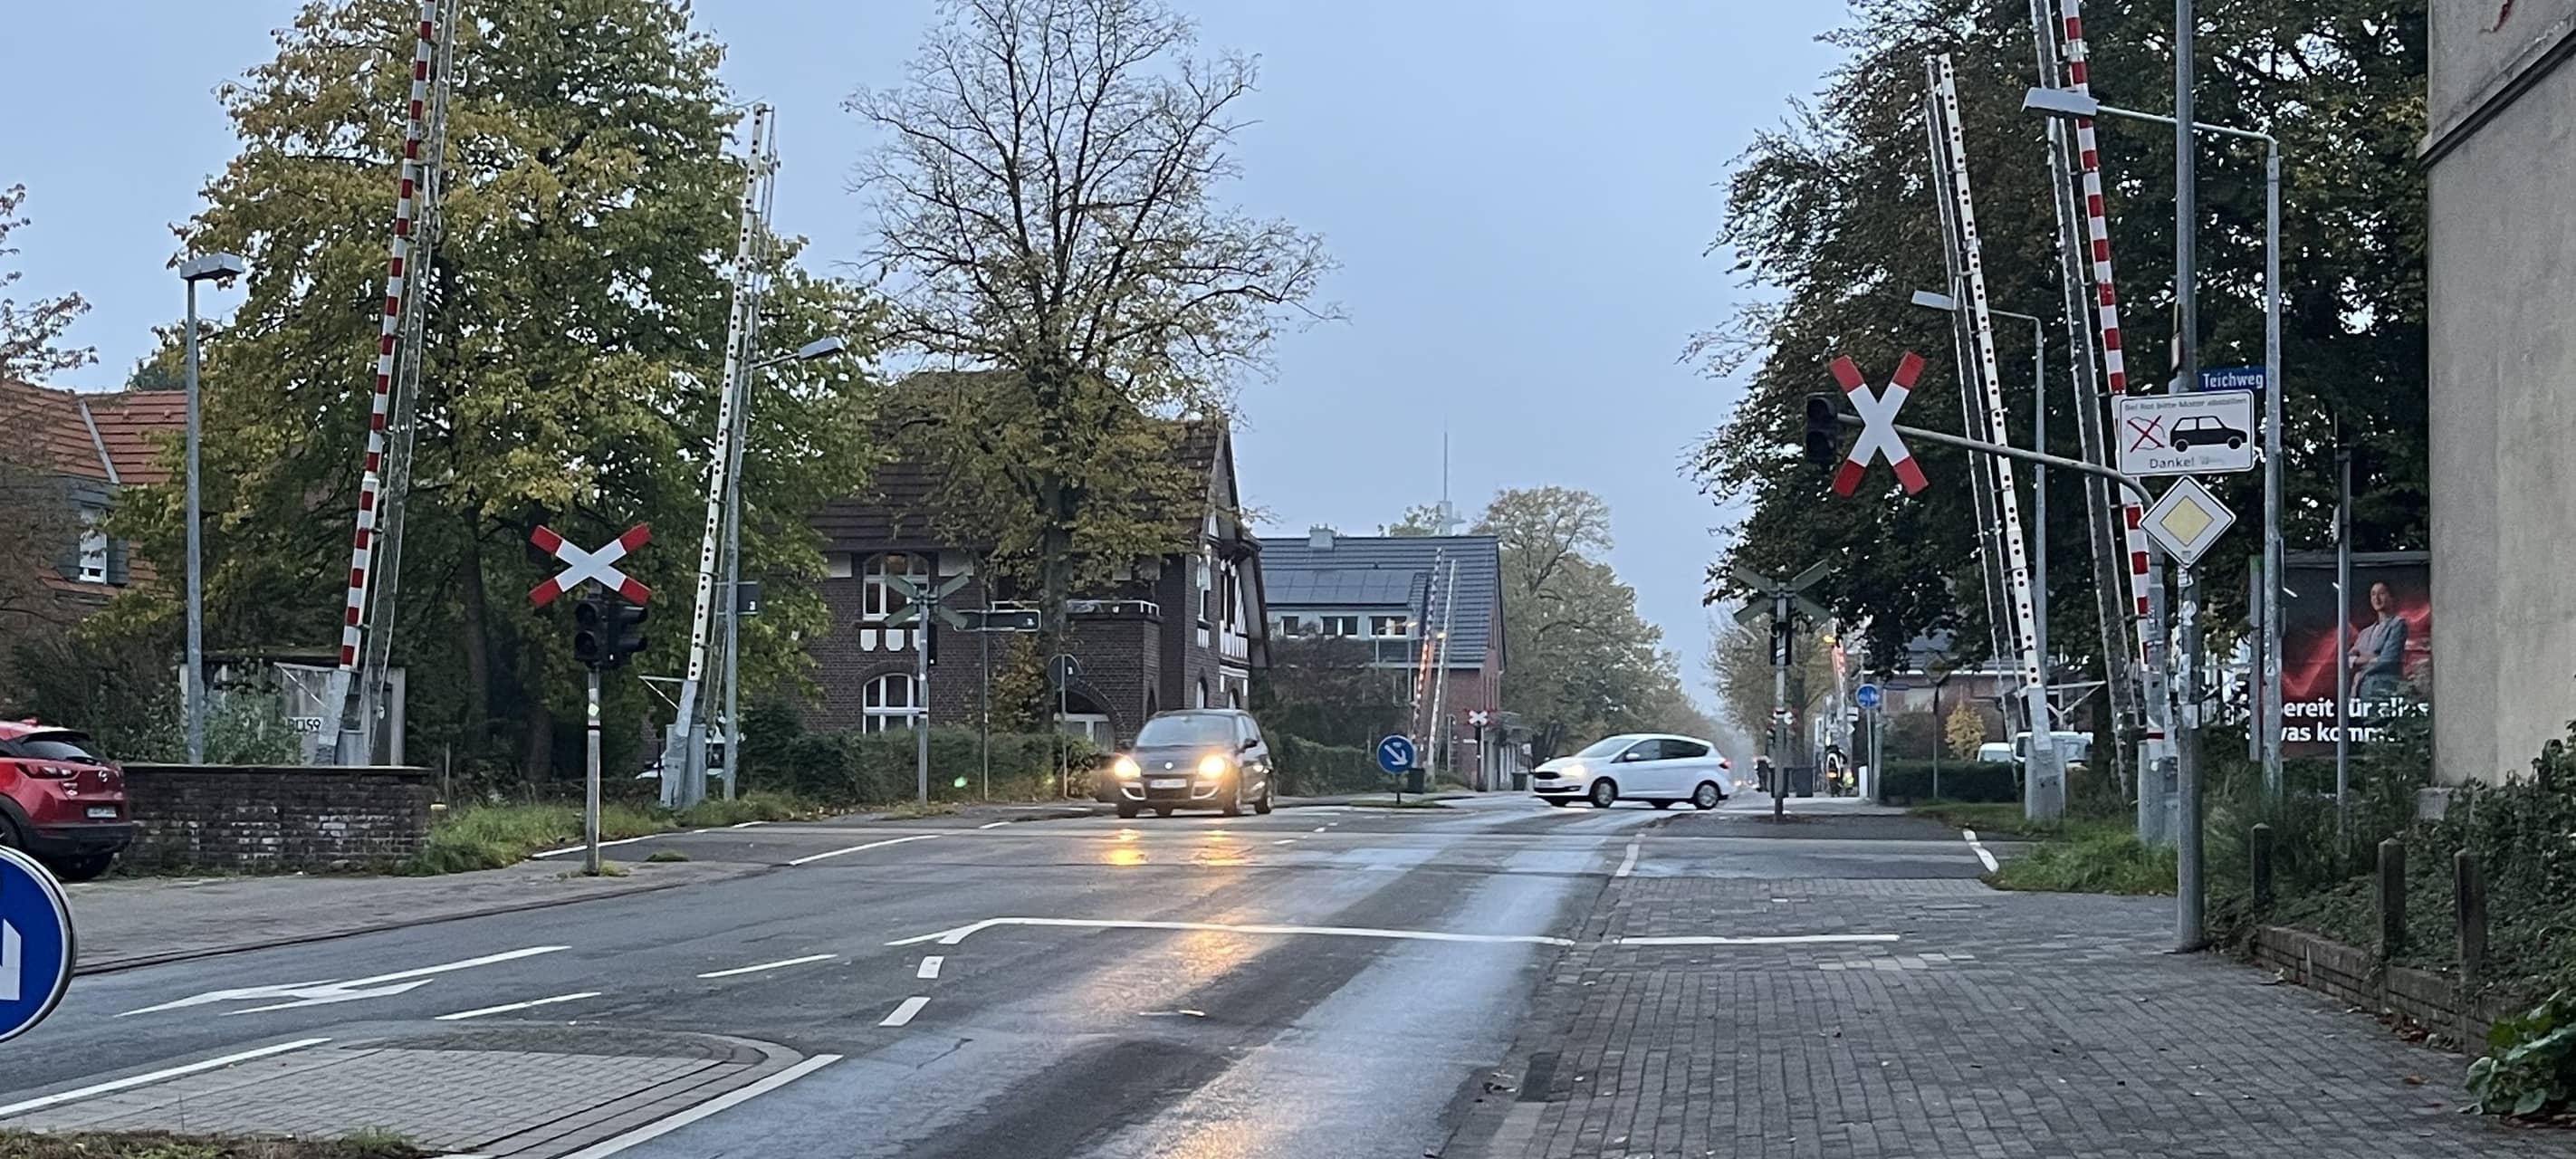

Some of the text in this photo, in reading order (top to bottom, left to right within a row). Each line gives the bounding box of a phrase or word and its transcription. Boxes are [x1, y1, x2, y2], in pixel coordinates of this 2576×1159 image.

[2202, 372, 2264, 389] Teichweg
[2280, 697, 2335, 718] ereit
[2347, 698, 2372, 718] ür
